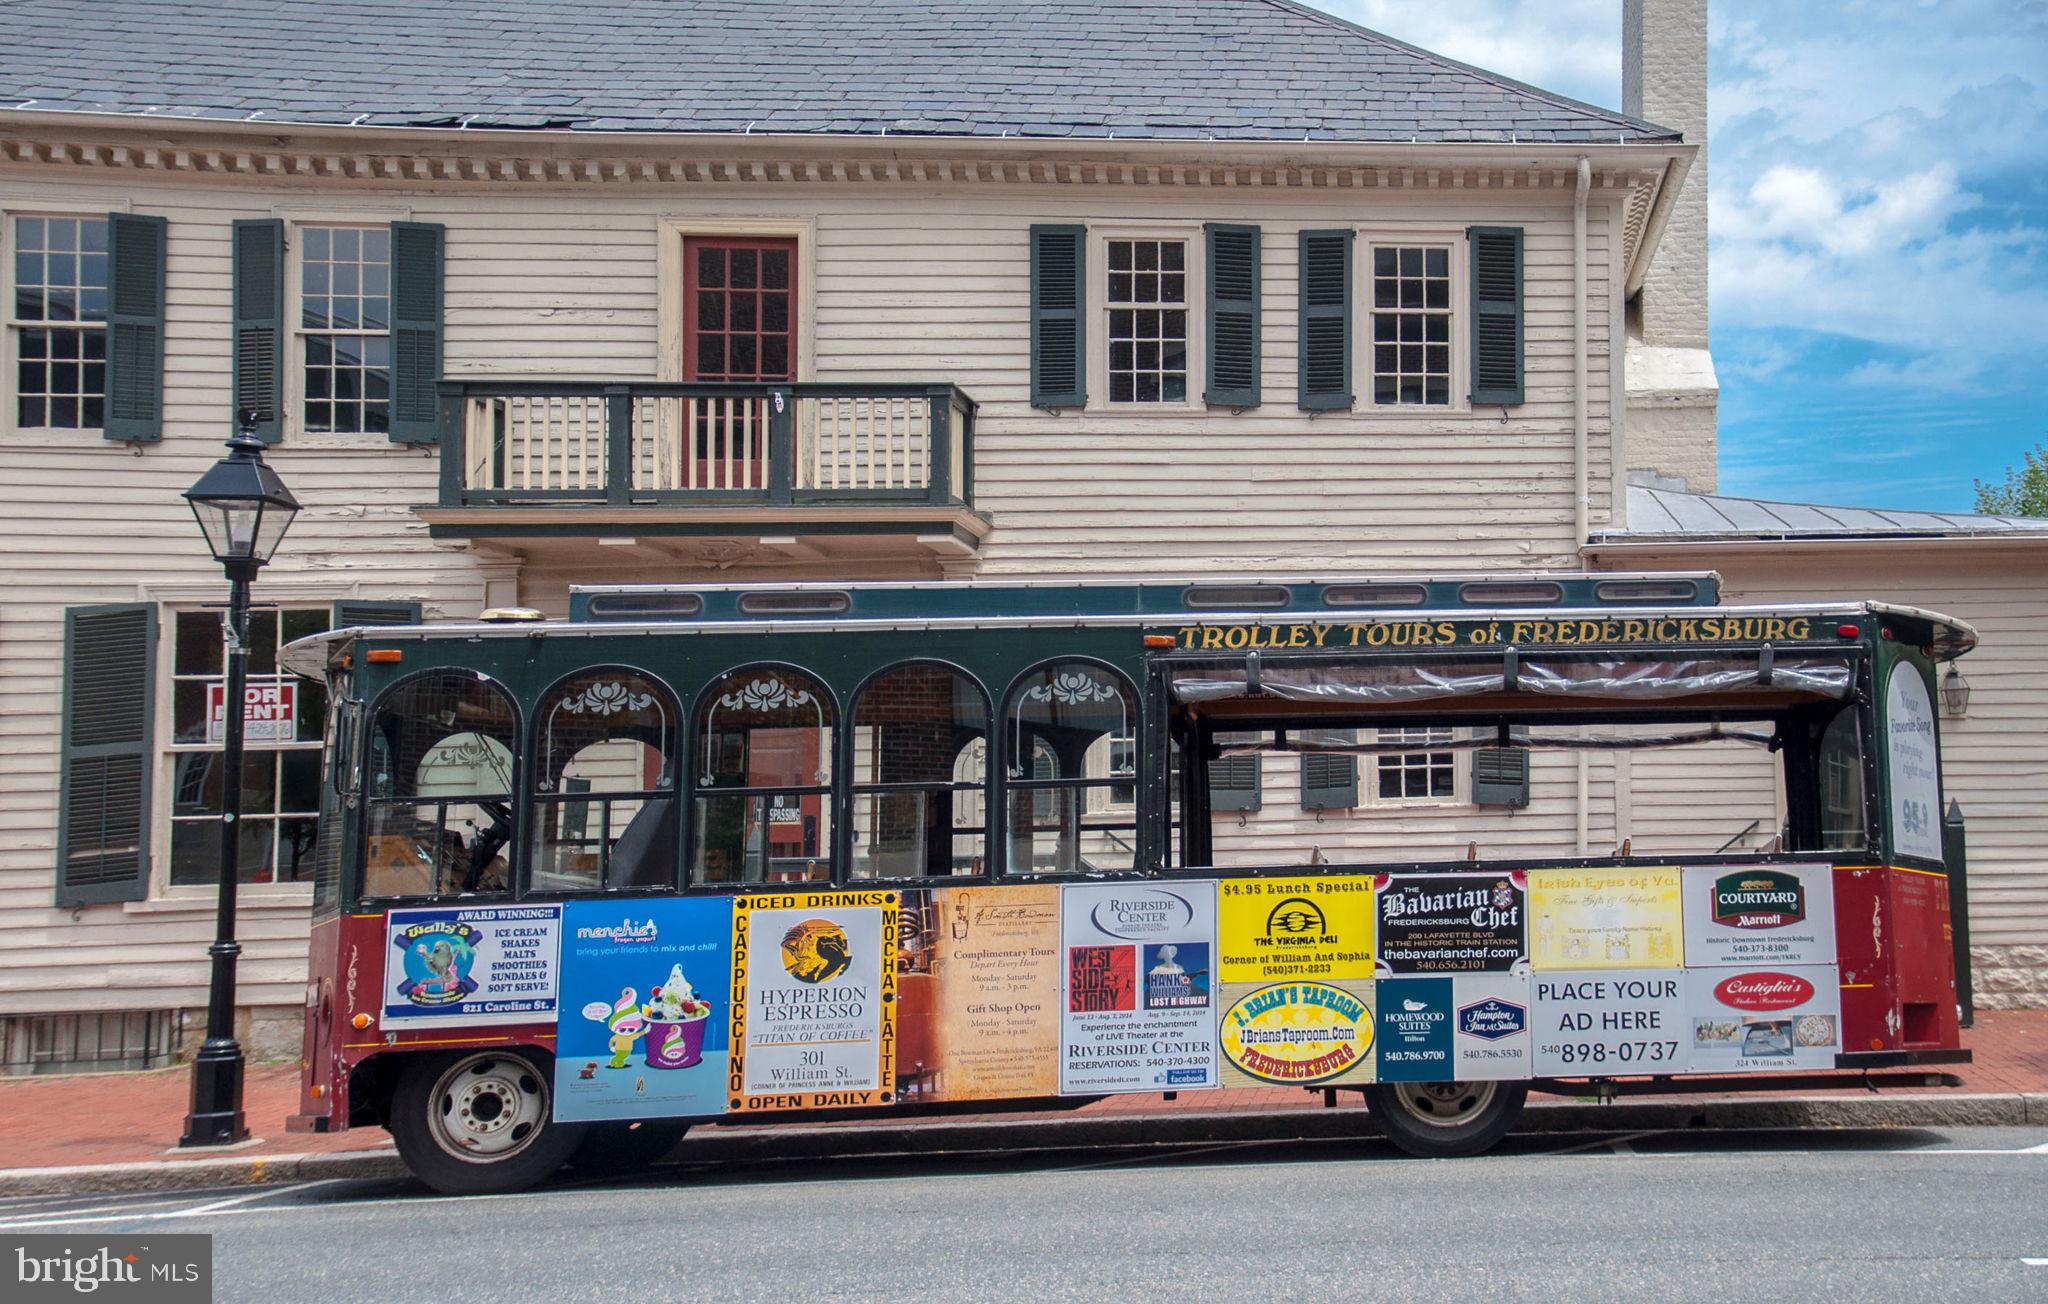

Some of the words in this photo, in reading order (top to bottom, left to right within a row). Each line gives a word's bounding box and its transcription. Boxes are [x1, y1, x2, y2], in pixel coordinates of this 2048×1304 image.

[1178, 624, 1333, 649] TROLLEY
[1345, 622, 1454, 645] TOURS
[1471, 621, 1498, 644] of
[1511, 617, 1810, 644] FREDERICKSBURG
[774, 795, 784, 807] NO
[1223, 884, 1261, 895] $4.95
[1267, 882, 1311, 894] Lunch
[1316, 881, 1369, 894] Special
[1583, 877, 1625, 891] Eyes
[750, 896, 795, 909] ICED
[807, 893, 882, 907] DRINKS
[1382, 887, 1490, 921] Bavarian
[1719, 892, 1797, 905] COURTYARD
[457, 911, 496, 921] AWARD
[498, 909, 553, 919] WINNING!!!
[1470, 906, 1518, 929] Chef
[1737, 914, 1780, 926] Marriott
[1388, 918, 1469, 926] FREDERICKSBURG
[408, 922, 469, 937] Wally's
[495, 929, 510, 937] ICE
[513, 928, 548, 937] CREAM
[501, 939, 540, 948] SHAKES
[1253, 938, 1273, 946] THE
[1276, 936, 1315, 945] VIRGINIA
[1319, 935, 1338, 944] DELI
[504, 950, 536, 959] MALTS
[576, 948, 598, 957] bring
[600, 947, 618, 955] your
[620, 945, 648, 954] friends
[661, 944, 676, 952] mix
[678, 944, 696, 952] and
[882, 910, 897, 990] MOCHA
[953, 948, 1027, 961] Complimentary
[1029, 947, 1055, 957] Tours
[1384, 947, 1518, 960] thebavarianchef.com
[1733, 944, 1789, 953] 540-373-8300
[1223, 955, 1257, 964] Corner
[1259, 954, 1269, 963] of
[1272, 953, 1311, 963] William
[1314, 952, 1334, 961] And
[1337, 952, 1370, 963] Sophia
[491, 961, 547, 970] SMOOTHIES
[1263, 964, 1331, 976] (540)371-2233
[1416, 960, 1485, 970] 540.656.2101
[491, 972, 538, 981] SUNDAES
[971, 974, 1000, 984] Monday
[1006, 973, 1037, 983] Saturday
[1072, 969, 1110, 989] SIDE
[488, 983, 513, 993] SOFT
[515, 982, 548, 991] SERVE!
[1538, 982, 1606, 1001] PLACE
[1613, 980, 1677, 999] YOUR
[1726, 979, 1801, 995] Castiglia's
[760, 986, 868, 1005] HYPERION
[1072, 990, 1119, 1011] STORY
[1150, 997, 1169, 1007] LOST
[462, 1004, 483, 1013] 821
[485, 1001, 532, 1012] Caroline
[730, 915, 748, 1091] CAPPUCCINO
[967, 1004, 985, 1014] Gift
[988, 1003, 1013, 1014] Shop
[1014, 1002, 1041, 1013] Open
[1301, 986, 1365, 1023] TAPROOM
[764, 1003, 863, 1021] ESPRESSO
[1385, 1013, 1444, 1022] HOMEWOOD
[1467, 1009, 1515, 1022] Hampton
[1081, 1023, 1125, 1032] Experience
[1143, 1020, 1198, 1028] enchantment
[1399, 1022, 1431, 1031] SUITES
[1494, 1021, 1519, 1031] Suites
[1558, 1013, 1593, 1031] AD
[1602, 1010, 1661, 1030] HERE
[800, 1032, 816, 1042] OF
[882, 1006, 894, 1087] LATTE
[1069, 1044, 1148, 1058] RIVERSIDE
[1152, 1041, 1210, 1054] CENTER
[1541, 1045, 1560, 1054] 540
[1561, 1041, 1679, 1063] 898-0737
[799, 1050, 824, 1066] 301
[1385, 1051, 1445, 1062] 540.786.9700
[1463, 1049, 1522, 1059] 540.786.5530
[1069, 1060, 1140, 1070] RESERVATIONS:
[1146, 1057, 1210, 1067] 540-370-4300
[1735, 1059, 1750, 1067] 324
[771, 1068, 829, 1081] William
[836, 1066, 853, 1079] St.
[1170, 1074, 1205, 1083] facebook
[748, 1095, 802, 1109] OPEN
[814, 1092, 871, 1106] DAILY
